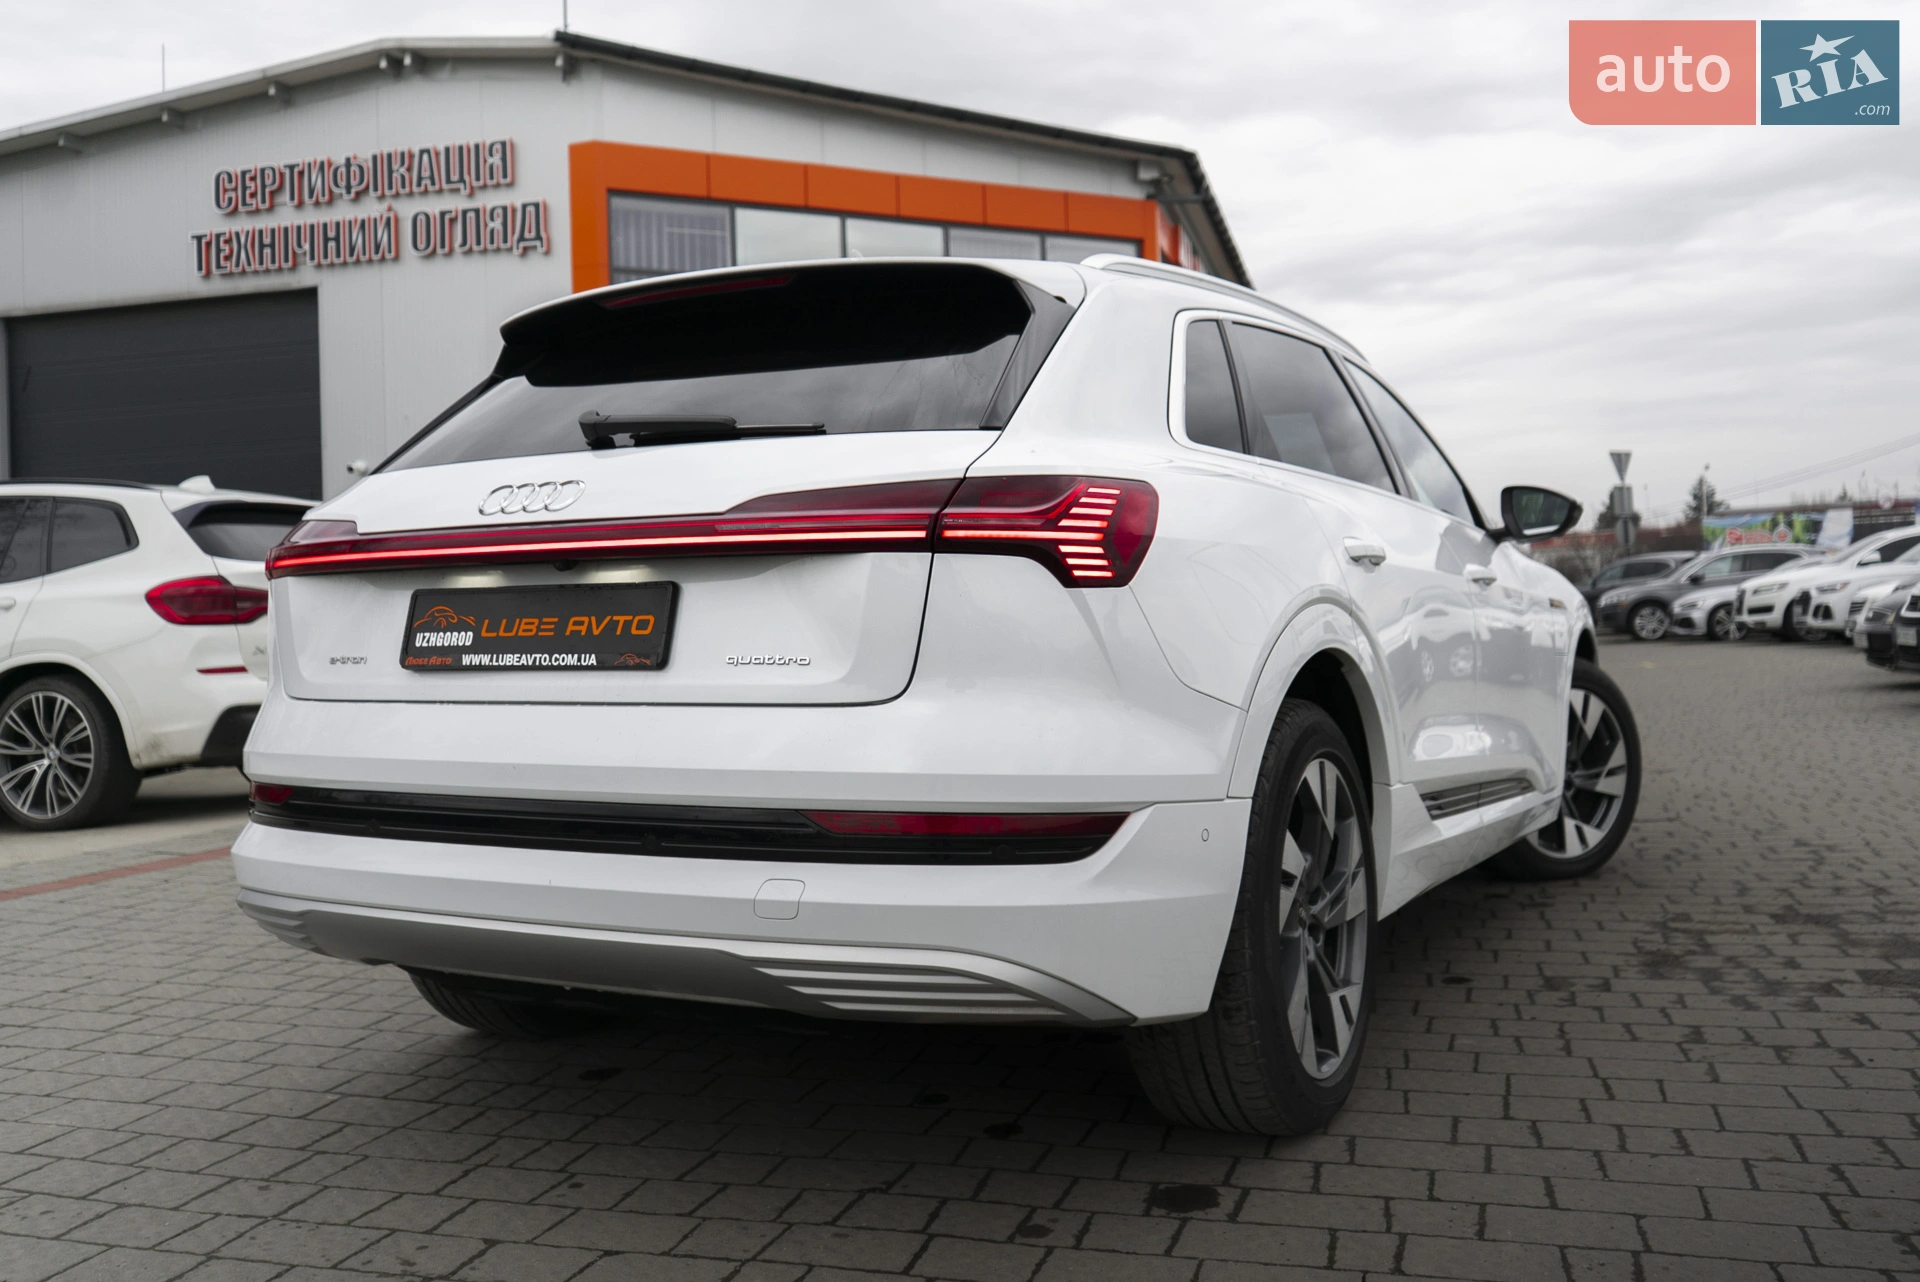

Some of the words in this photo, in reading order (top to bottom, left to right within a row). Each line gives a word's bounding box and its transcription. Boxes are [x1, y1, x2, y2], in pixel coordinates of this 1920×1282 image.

[213, 137, 515, 214] СЕРТИФІКАЦІЯ
[190, 203, 399, 276] ТЕХНІЧНИЙ
[409, 198, 549, 256] ОГЛЯД
[481, 618, 558, 637] LUBE
[565, 615, 655, 636] AVTO
[414, 631, 474, 647] UZHGOROD
[462, 653, 597, 666] WWW.LUBEAVTO.COM.UA
[725, 653, 811, 667] quattro
